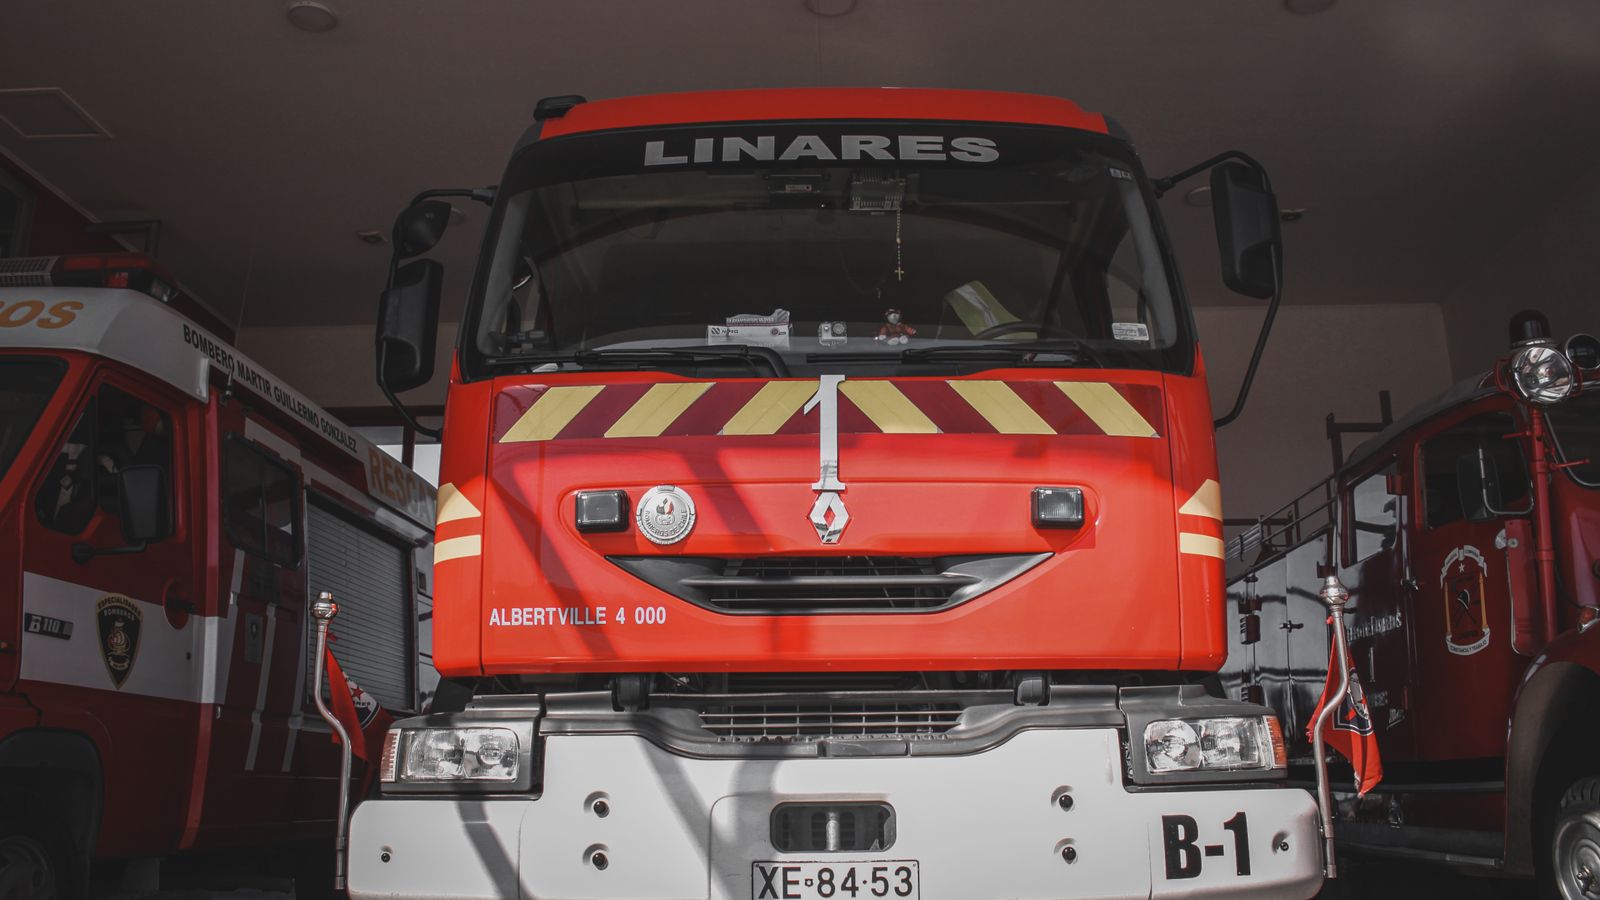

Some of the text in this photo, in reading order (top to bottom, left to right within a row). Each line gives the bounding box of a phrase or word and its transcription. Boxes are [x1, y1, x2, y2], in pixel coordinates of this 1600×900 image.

[643, 134, 1000, 167] LINARES
[0, 300, 84, 329] OS
[183, 323, 358, 454] BOMBERO MARTIR GUILLERMO GONZALEZ
[803, 374, 847, 492] 1
[644, 509, 669, 537] BOMBEROS
[678, 508, 688, 530] CHILE
[489, 606, 667, 626] ALBERTVILLE 4 000
[1161, 811, 1252, 880] B-1
